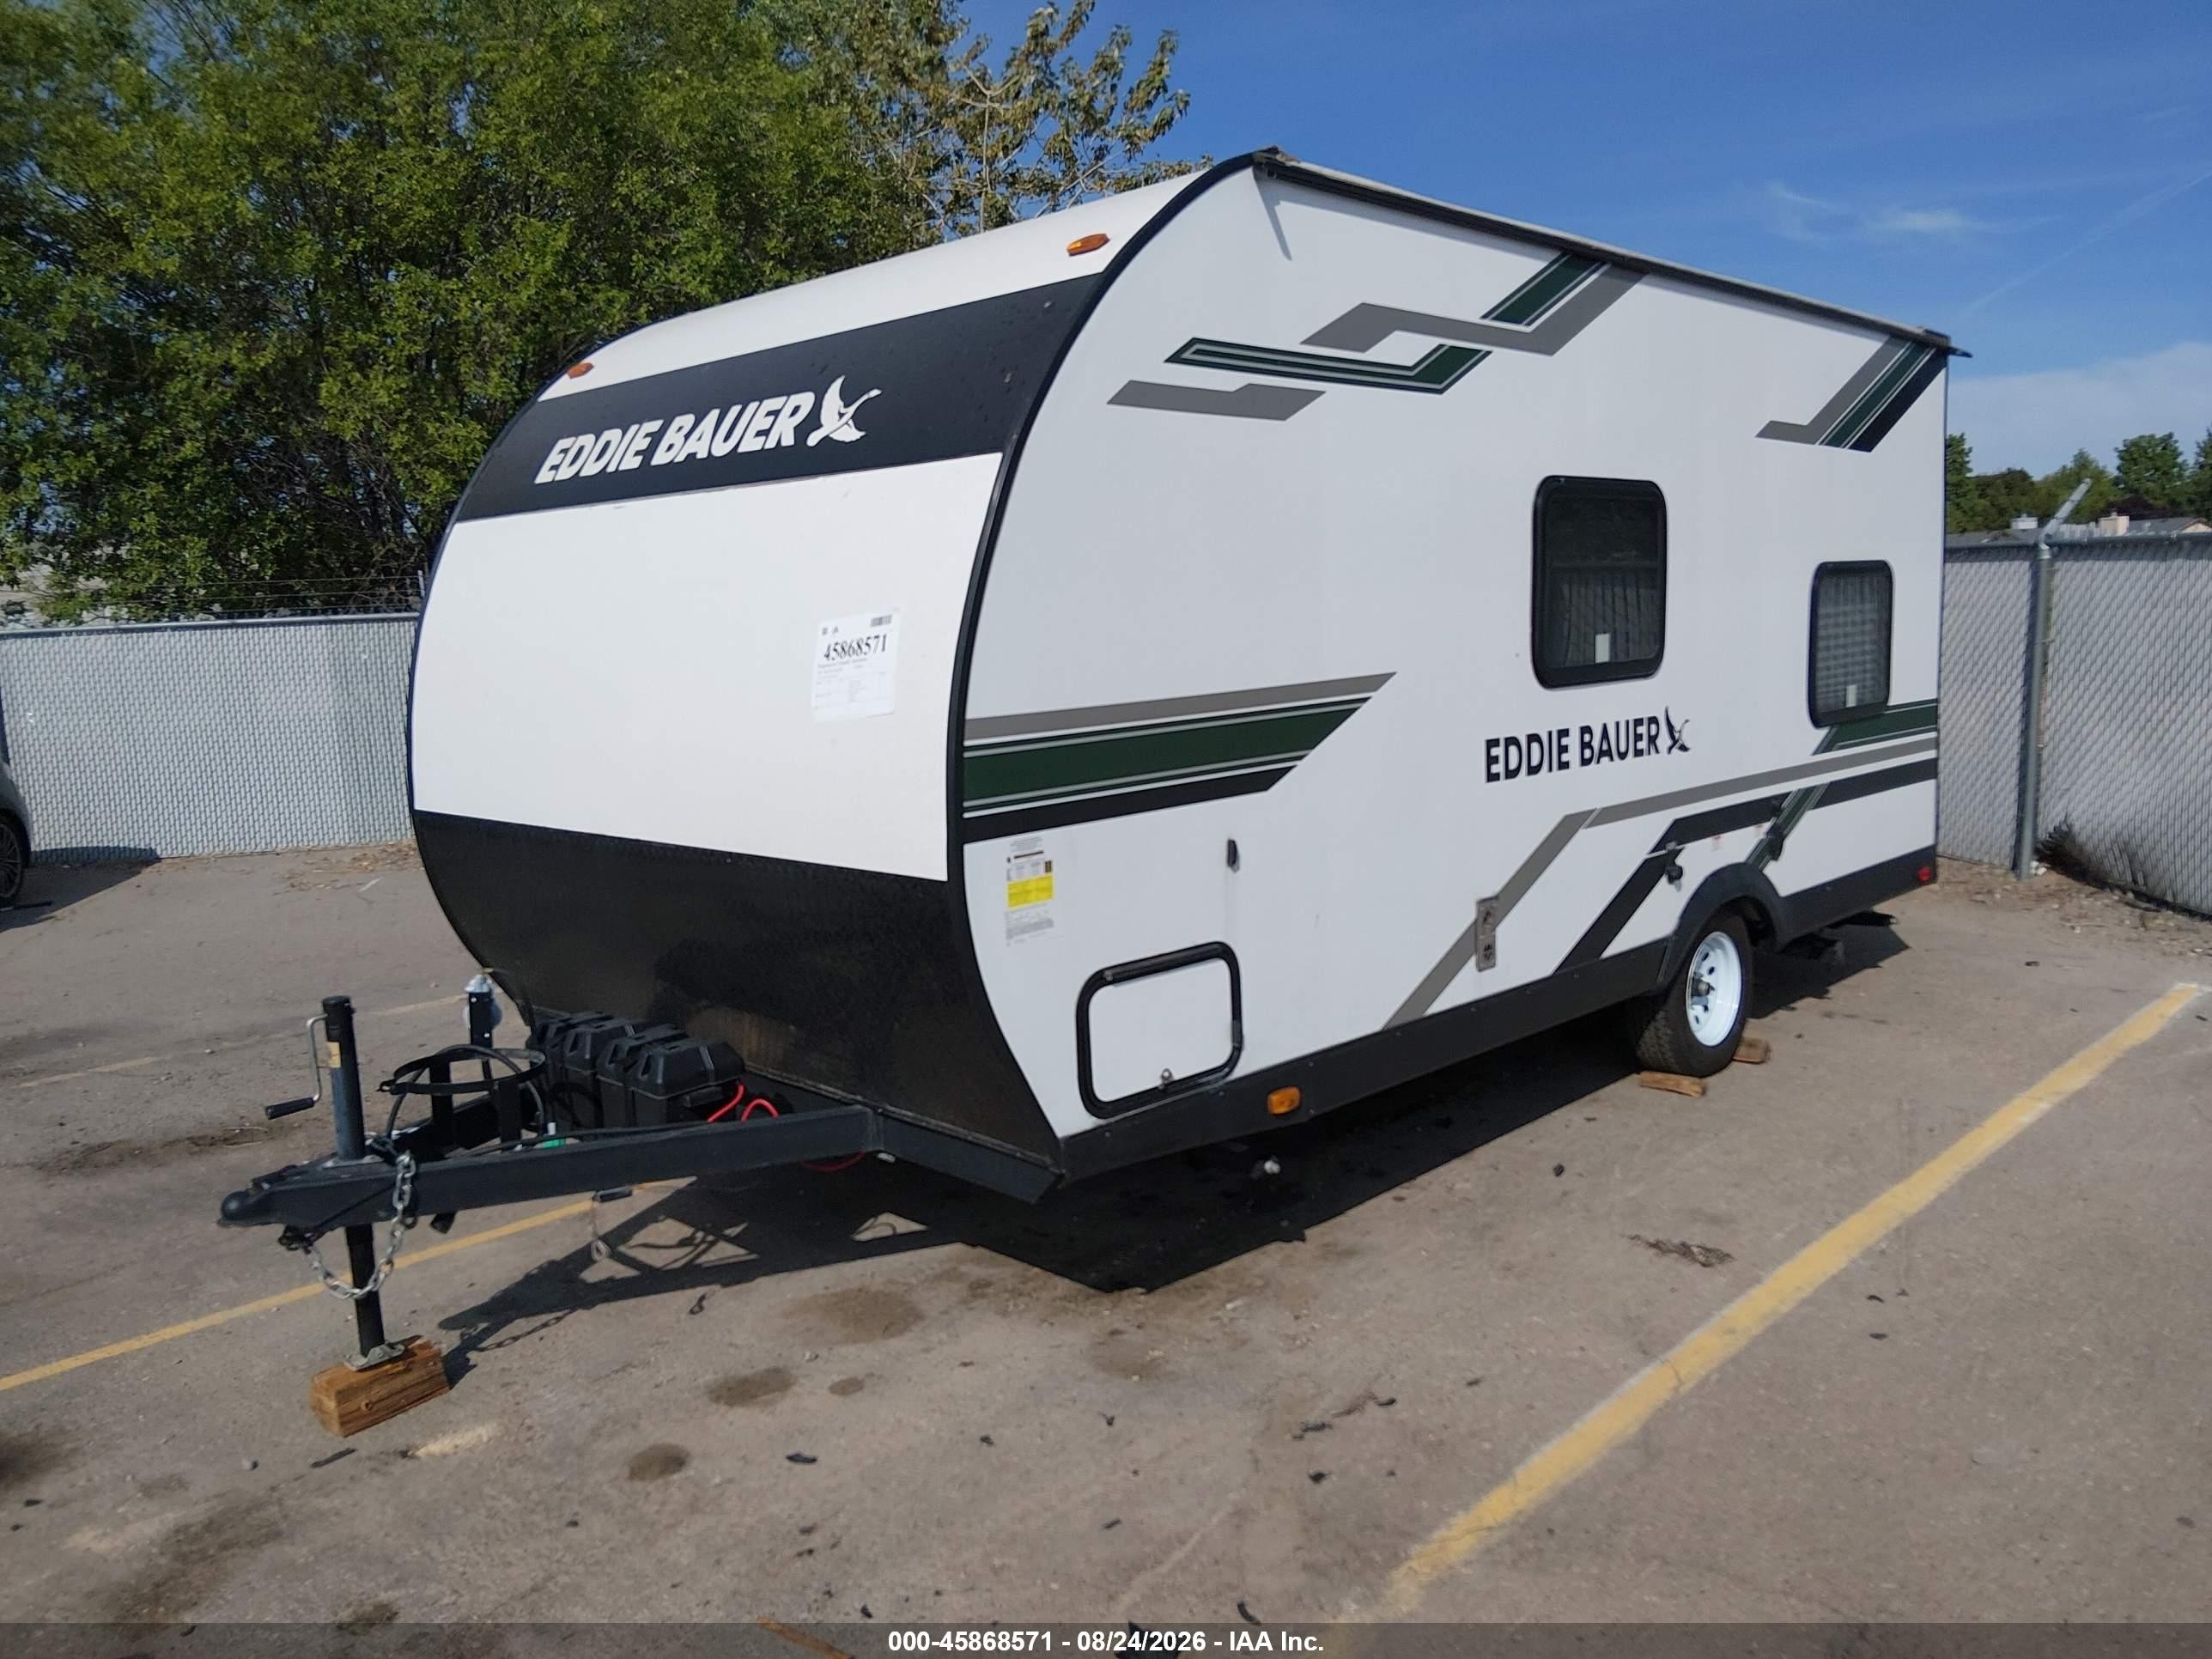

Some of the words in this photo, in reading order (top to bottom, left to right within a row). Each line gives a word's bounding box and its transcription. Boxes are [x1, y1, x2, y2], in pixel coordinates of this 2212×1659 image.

[534, 419, 664, 484] EDDIE
[651, 391, 815, 466] BAUER
[823, 634, 888, 662] 45868571
[1486, 727, 1571, 783] EDDIE
[1578, 715, 1661, 767] BAUER
